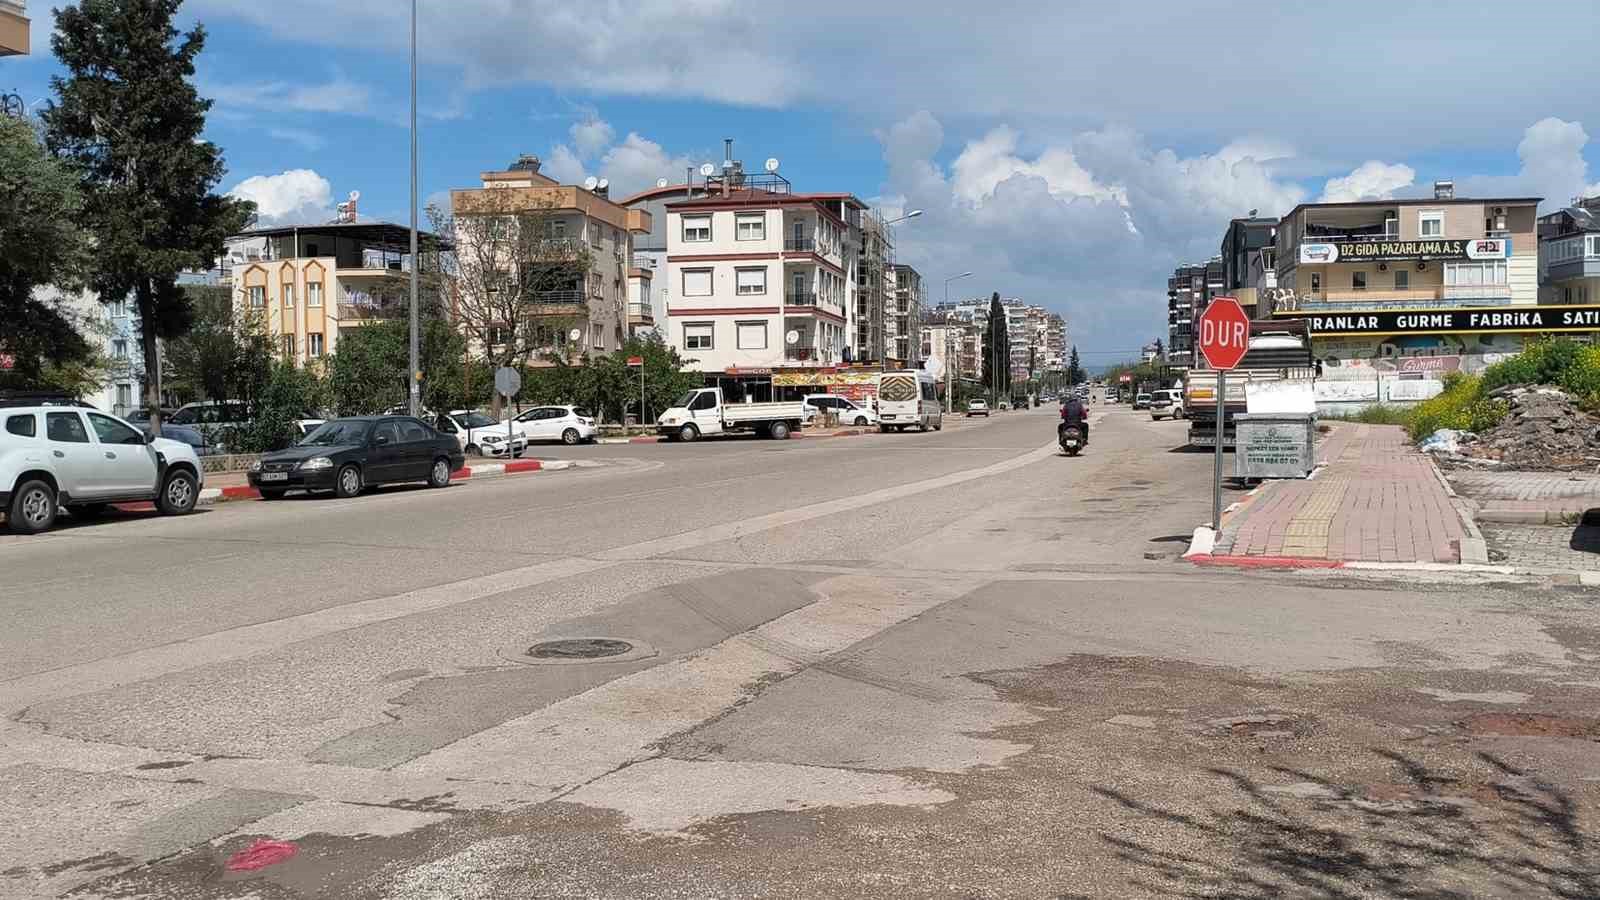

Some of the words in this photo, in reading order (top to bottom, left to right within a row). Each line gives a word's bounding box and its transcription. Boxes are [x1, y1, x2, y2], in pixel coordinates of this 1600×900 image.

[1341, 244, 1354, 256] D2
[1355, 243, 1379, 256] GIDA
[1381, 241, 1441, 255] PAZARLAMA
[1396, 314, 1453, 328] GURME
[1203, 319, 1245, 348] DUR
